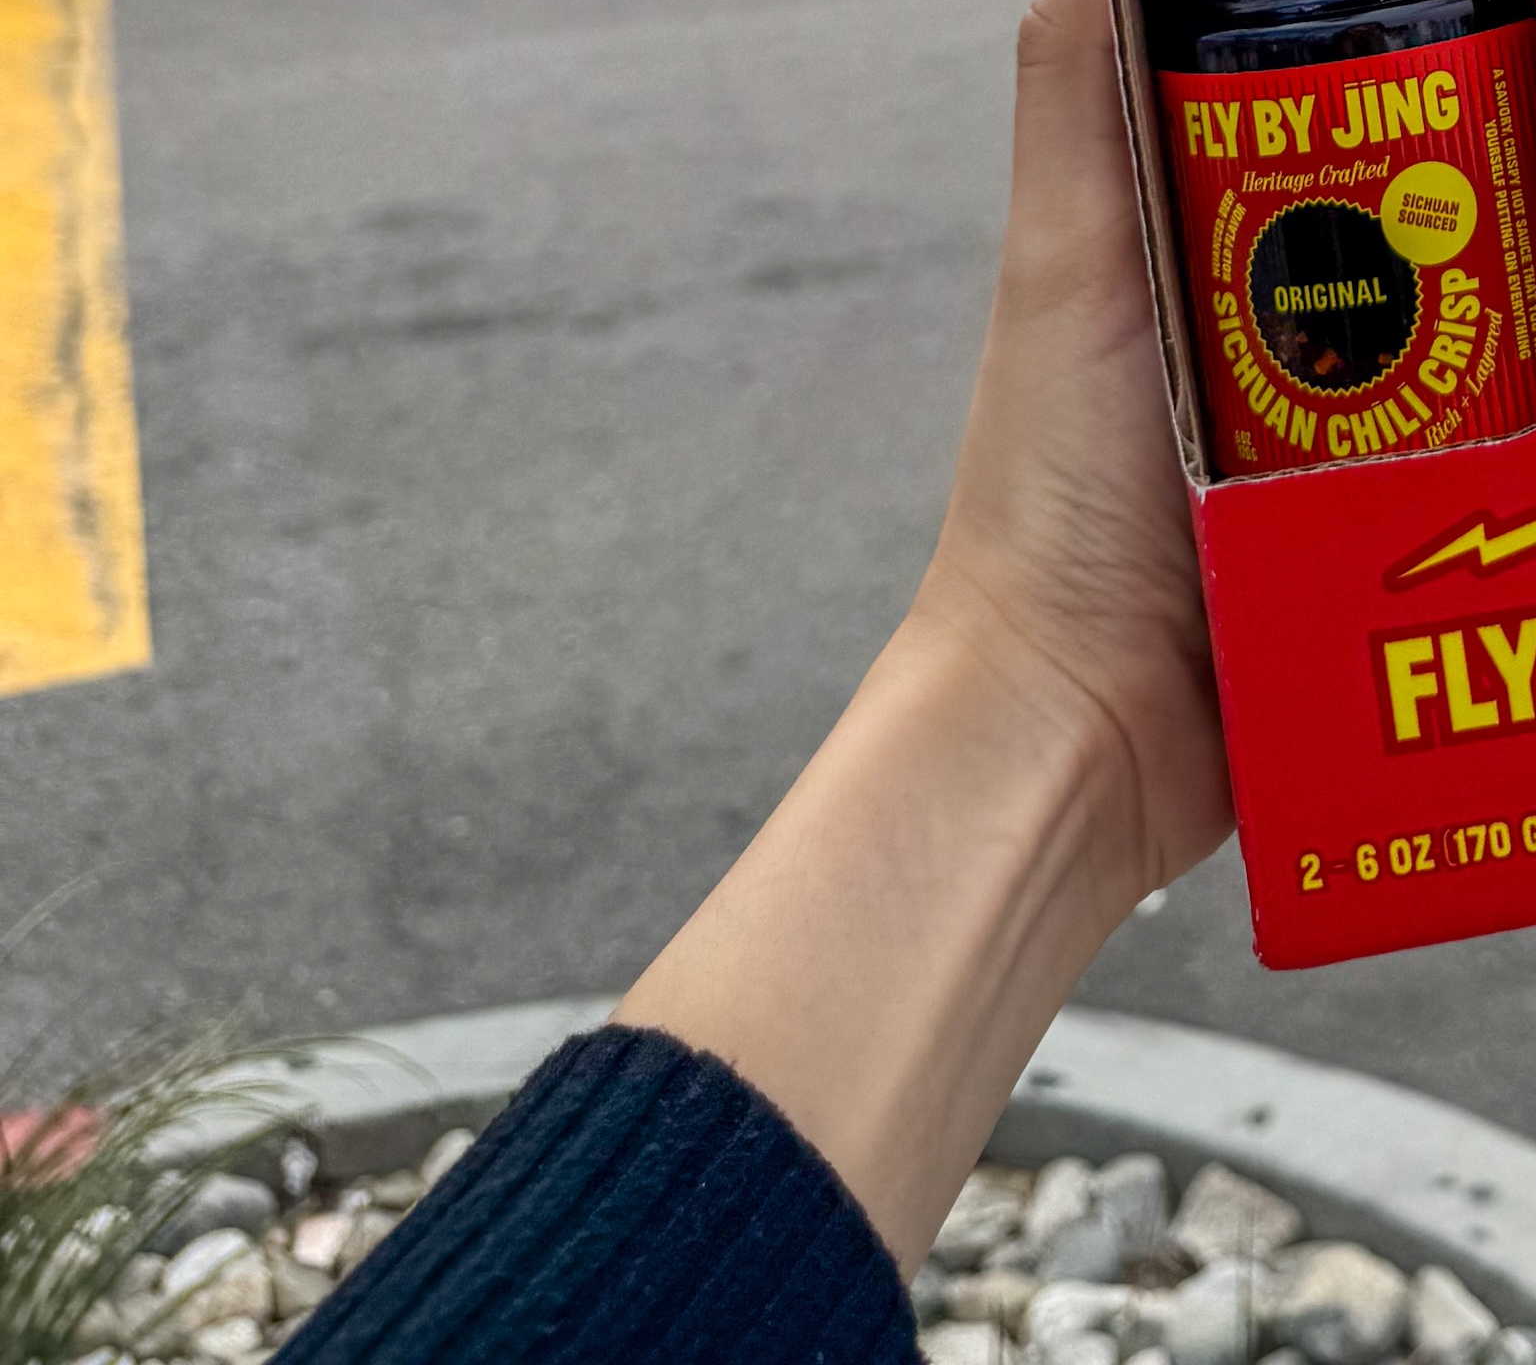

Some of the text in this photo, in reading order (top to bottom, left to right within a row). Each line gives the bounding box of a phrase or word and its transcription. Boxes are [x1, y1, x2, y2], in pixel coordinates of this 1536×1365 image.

[1493, 69, 1504, 80] A
[1183, 101, 1241, 158] FLY
[1252, 94, 1315, 157] BY
[1241, 155, 1391, 193] Heritage Crafted
[1398, 209, 1457, 232] SOURCED
[1511, 189, 1525, 216] HOT
[1485, 119, 1531, 360] YOURSELF PUTTING ON EVERYTHING
[1515, 218, 1532, 264] SAUCE
[1274, 276, 1387, 312] ORIGINAL
[1424, 408, 1462, 448] Rich
[1464, 308, 1503, 397] Layered
[1300, 853, 1324, 892] 2
[1356, 843, 1379, 882] 6
[1388, 834, 1436, 876] OZ
